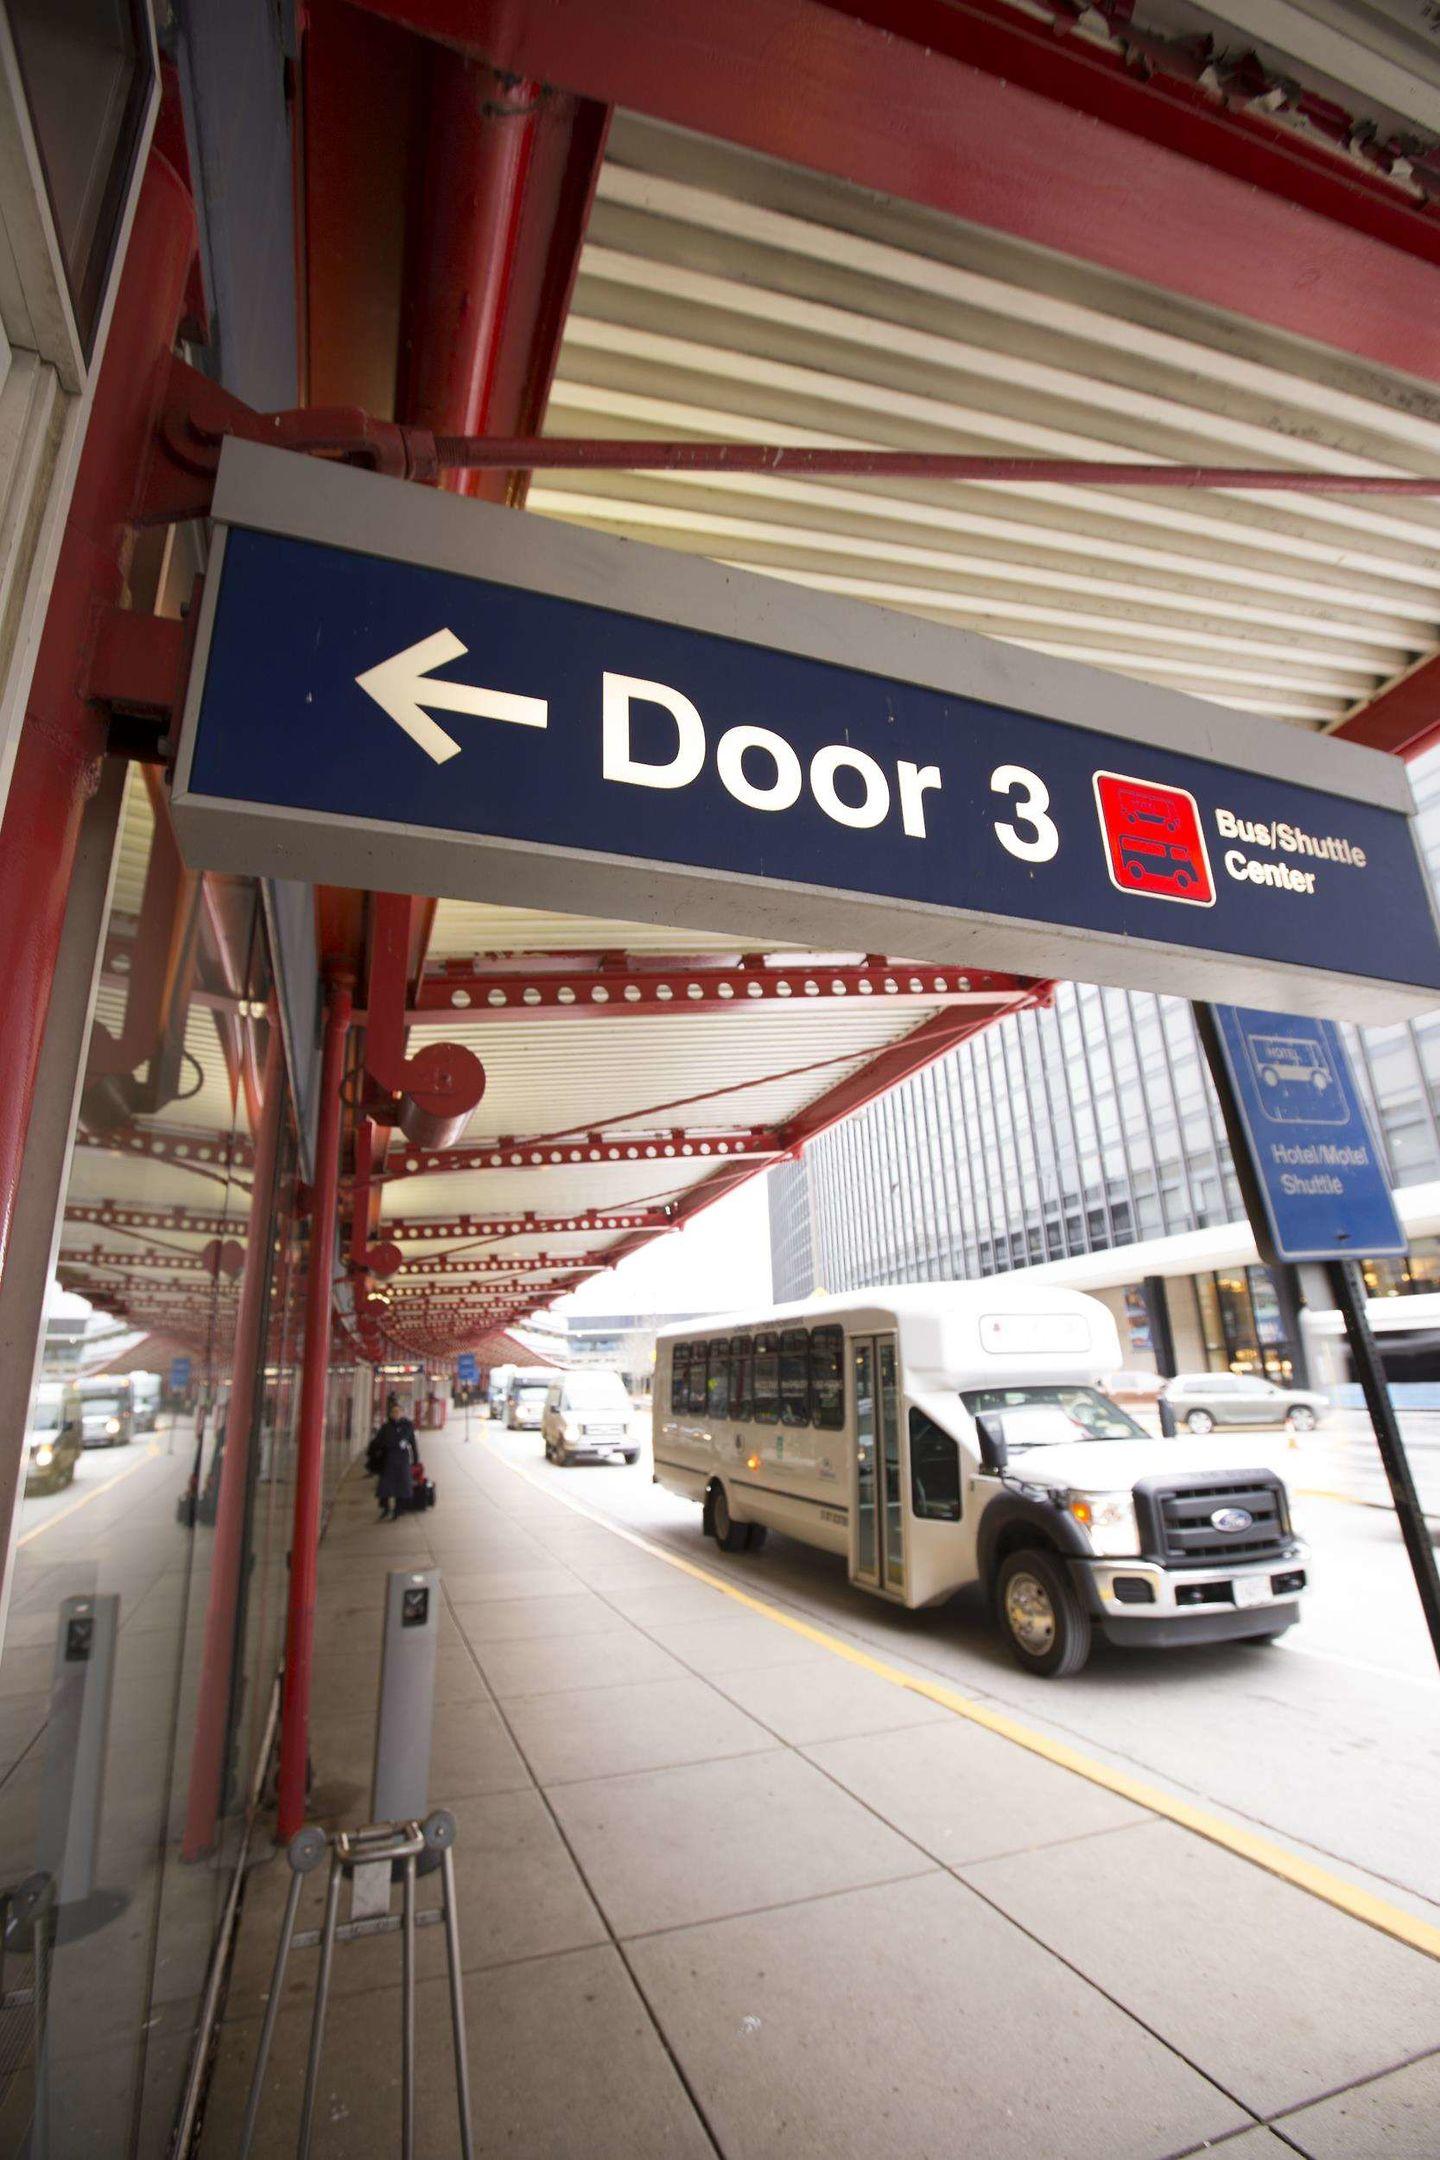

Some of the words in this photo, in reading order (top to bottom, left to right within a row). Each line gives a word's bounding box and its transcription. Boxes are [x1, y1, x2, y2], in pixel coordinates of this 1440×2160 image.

[602, 671, 942, 839] Door
[990, 764, 1060, 863] 3
[1215, 808, 1367, 868] Bus/Shuttle
[1224, 850, 1316, 894] Center
[1271, 1144, 1369, 1166] Hotel/Motel
[1280, 1173, 1344, 1195] Shuttle
